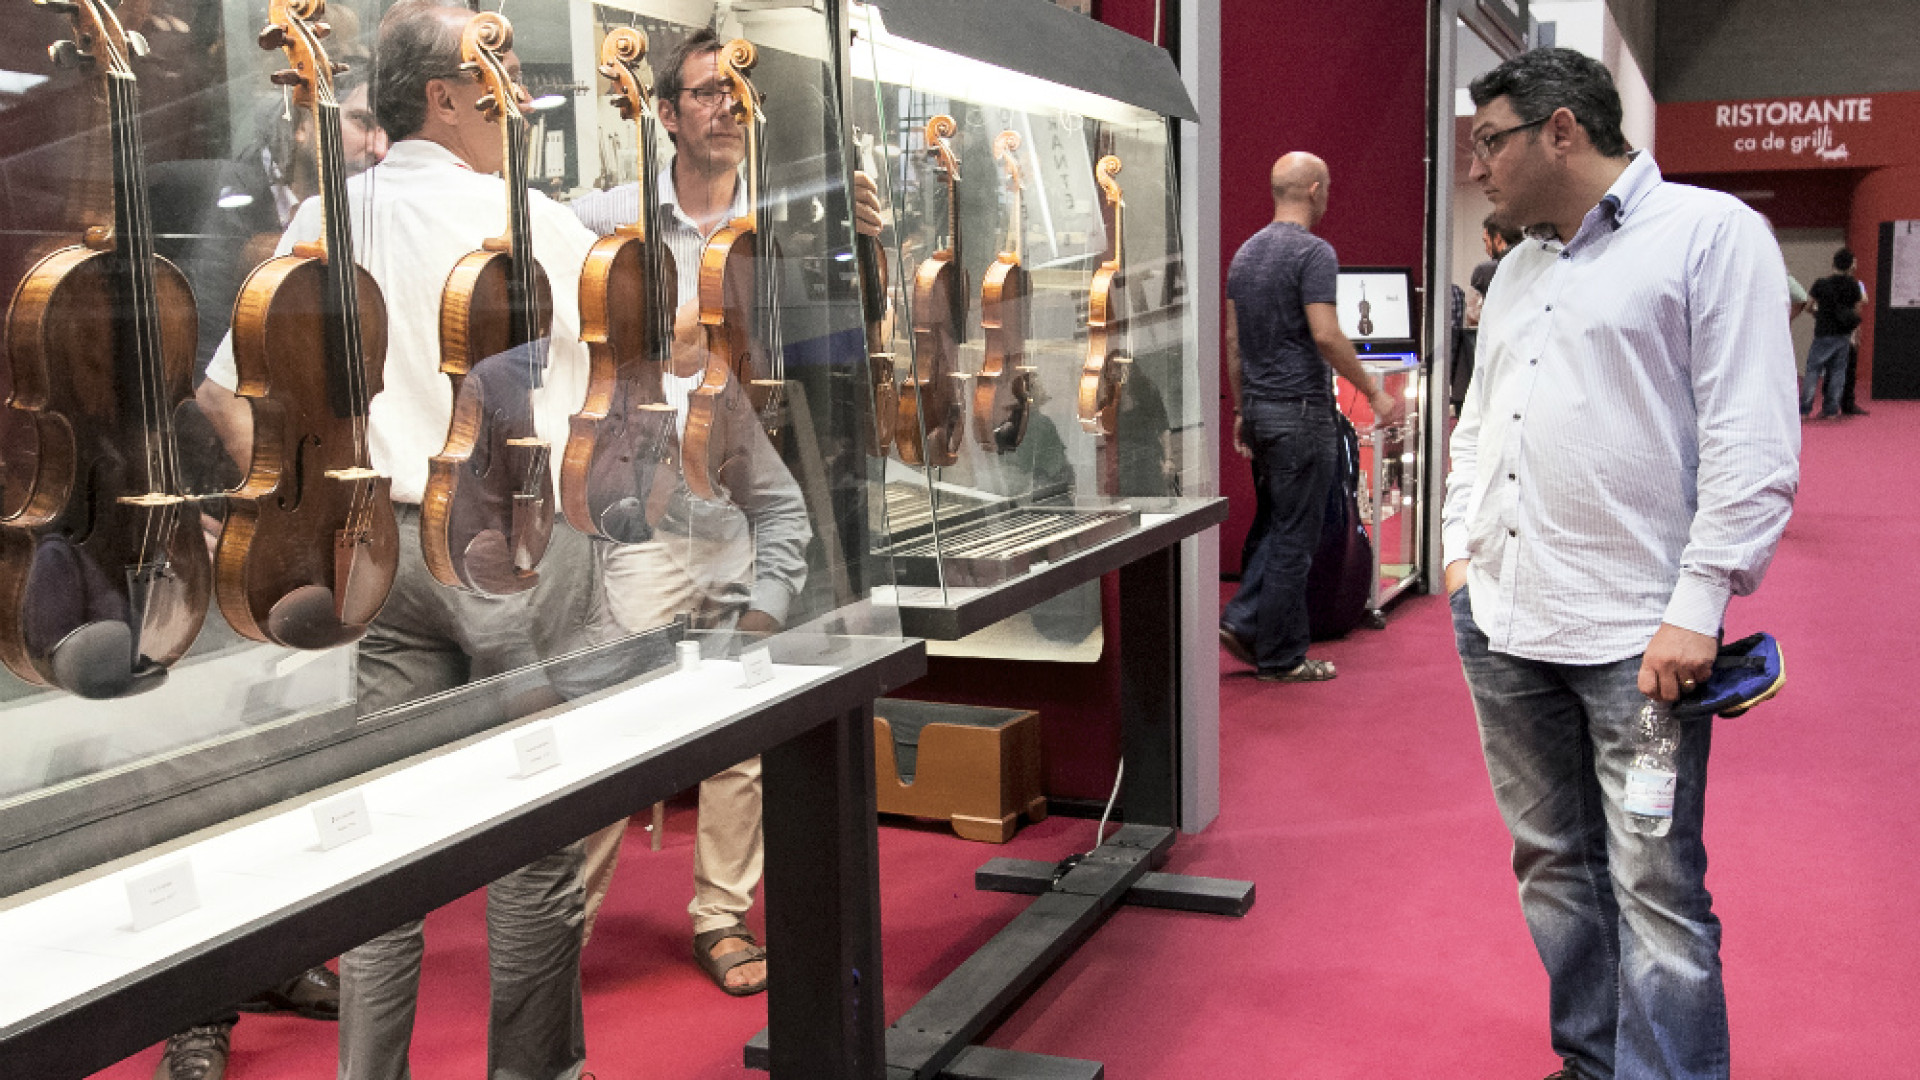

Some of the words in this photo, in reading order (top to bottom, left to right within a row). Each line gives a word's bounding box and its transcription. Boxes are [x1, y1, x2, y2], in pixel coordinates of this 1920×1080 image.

[1716, 98, 1871, 127] RISTORANTE
[1734, 138, 1756, 151] ca
[1761, 130, 1785, 150] de
